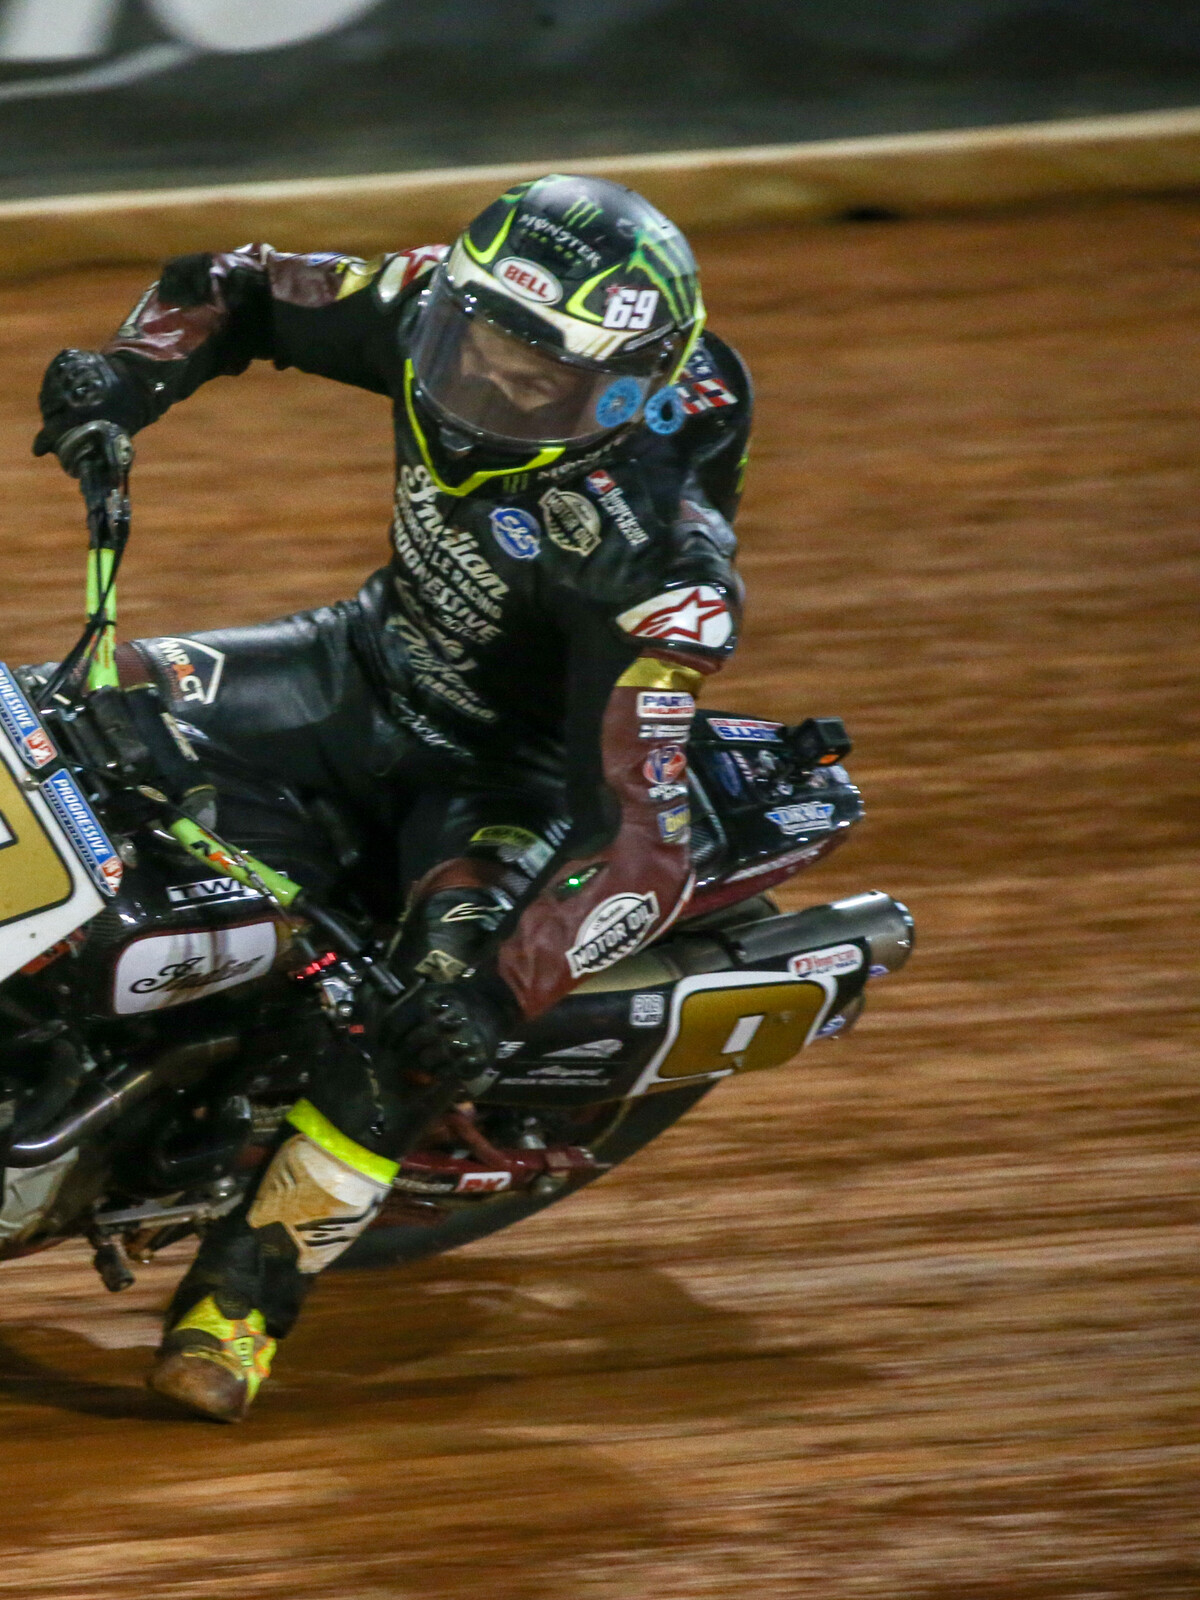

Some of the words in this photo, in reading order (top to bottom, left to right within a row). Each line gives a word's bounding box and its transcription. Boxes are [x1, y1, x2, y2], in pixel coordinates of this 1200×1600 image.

[517, 213, 602, 269] MONSTER
[503, 264, 550, 298] BELL
[603, 288, 659, 330] 69
[495, 512, 536, 551] S&S
[52, 779, 110, 856] PROGRESSIVE
[573, 920, 627, 966] MOTOR
[625, 903, 650, 931] OIL
